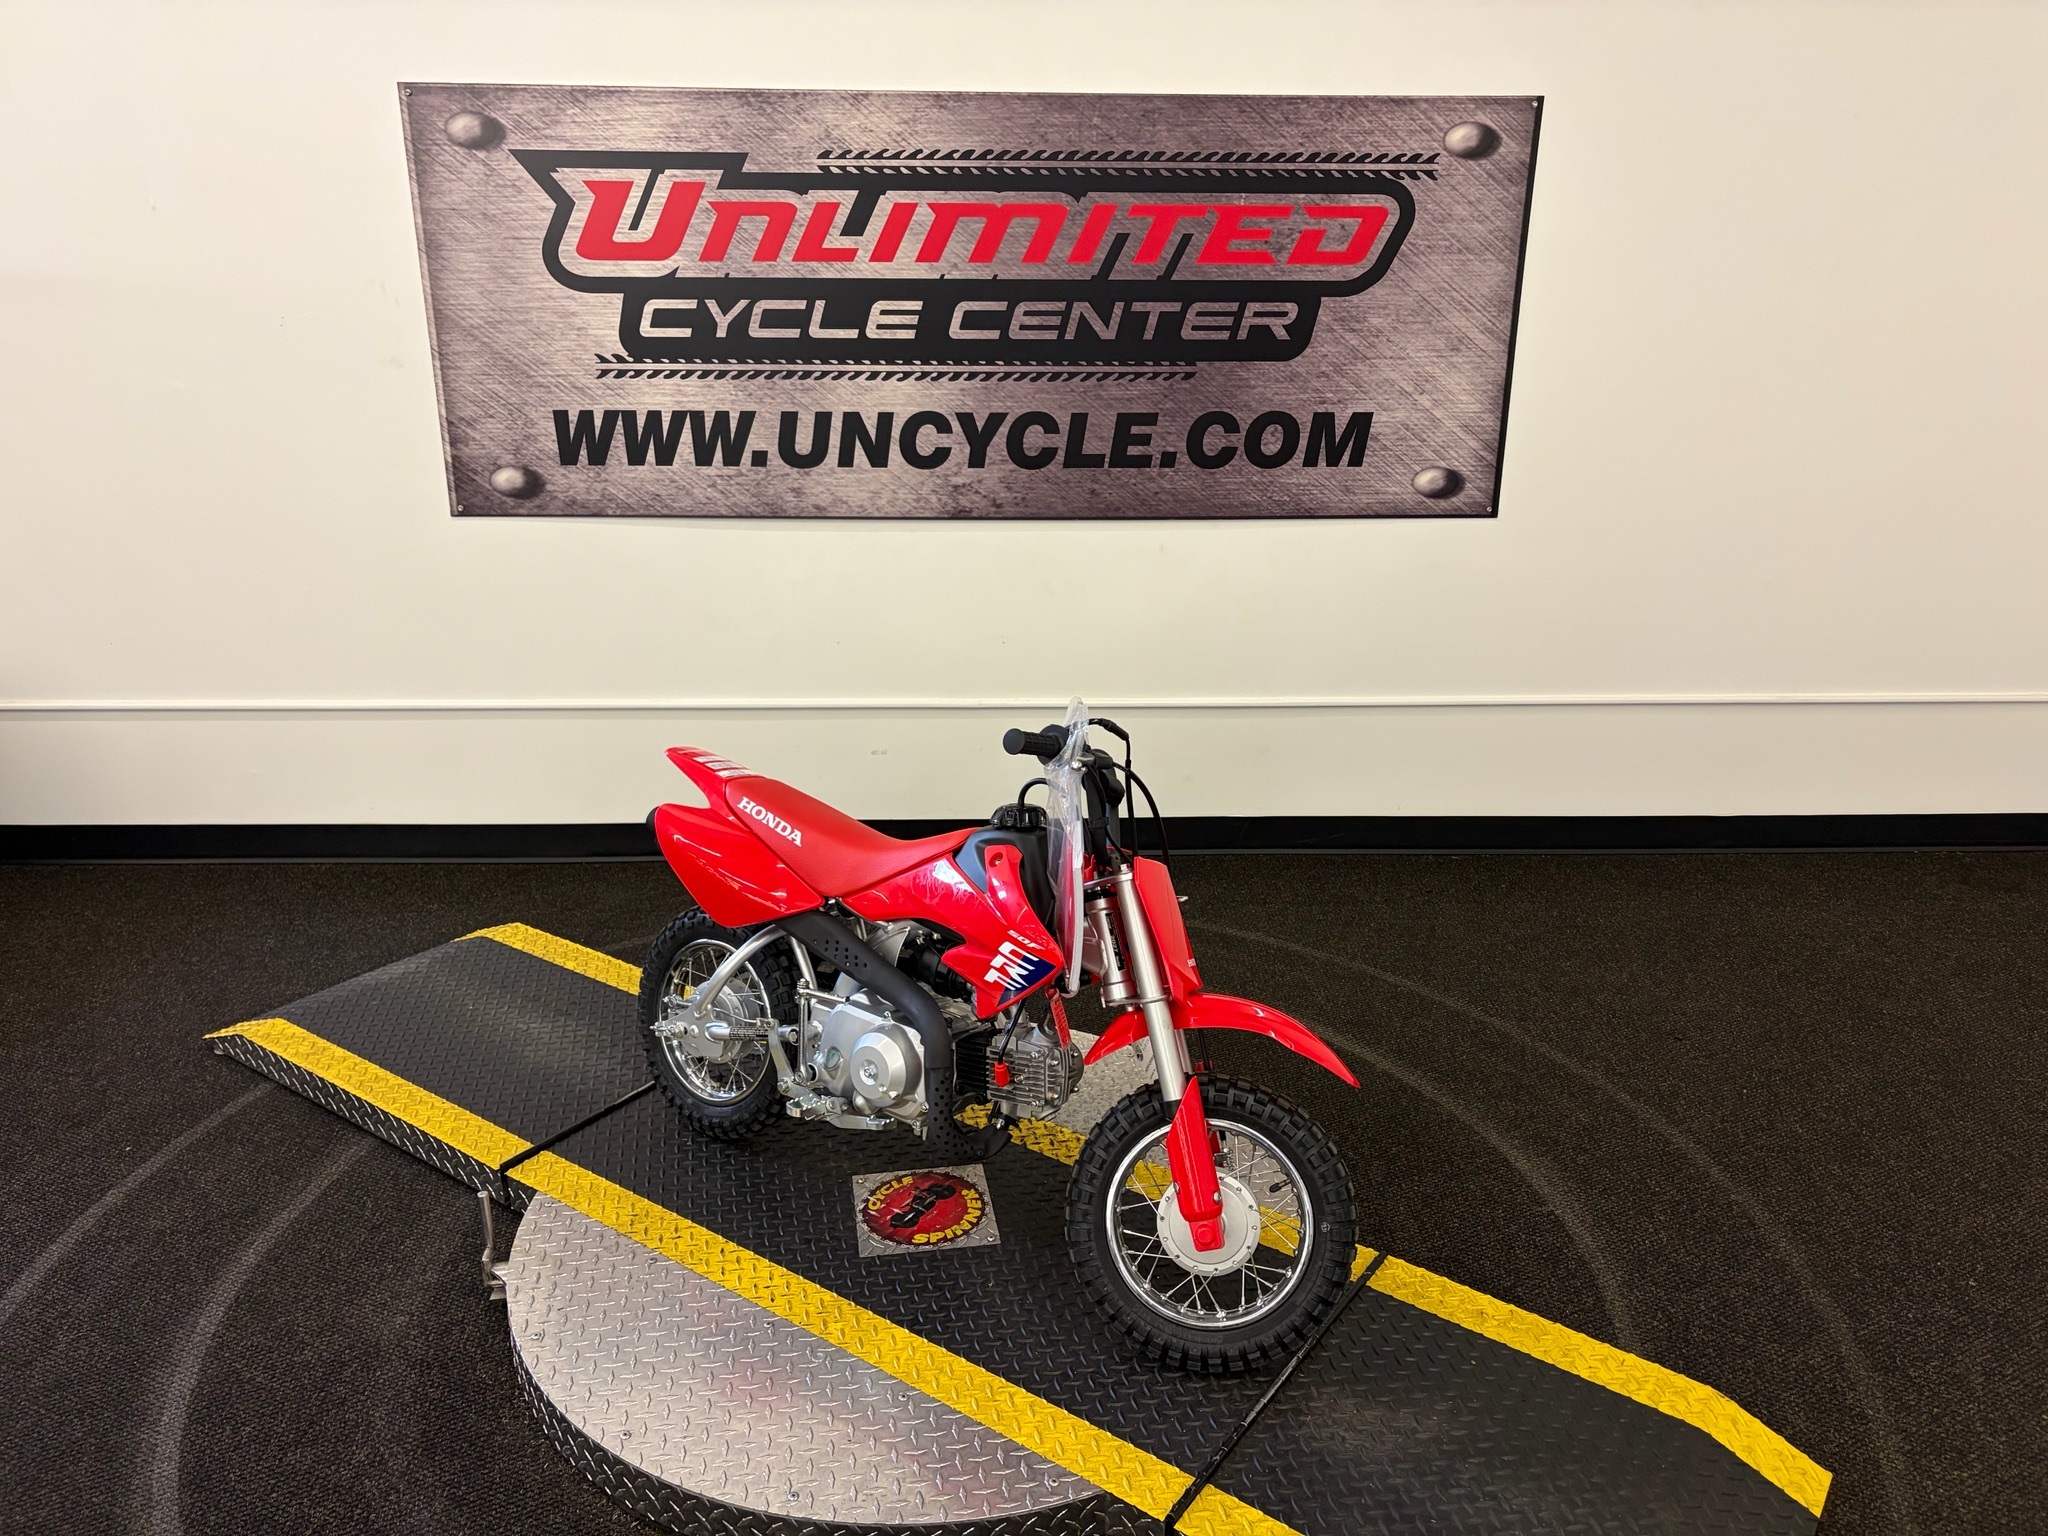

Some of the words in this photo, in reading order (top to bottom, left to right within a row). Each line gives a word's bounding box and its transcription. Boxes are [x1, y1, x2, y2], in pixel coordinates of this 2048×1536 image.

[575, 180, 1390, 266] UNLIMITED
[638, 298, 924, 340] CYCLE
[948, 300, 1299, 341] CENTER
[552, 408, 1374, 470] WWW.UNCYCLE.COM
[736, 796, 803, 848] HONDA
[1006, 929, 1047, 951] 50F
[867, 1175, 914, 1211] CYCLE
[911, 1188, 983, 1244] SPINNER
